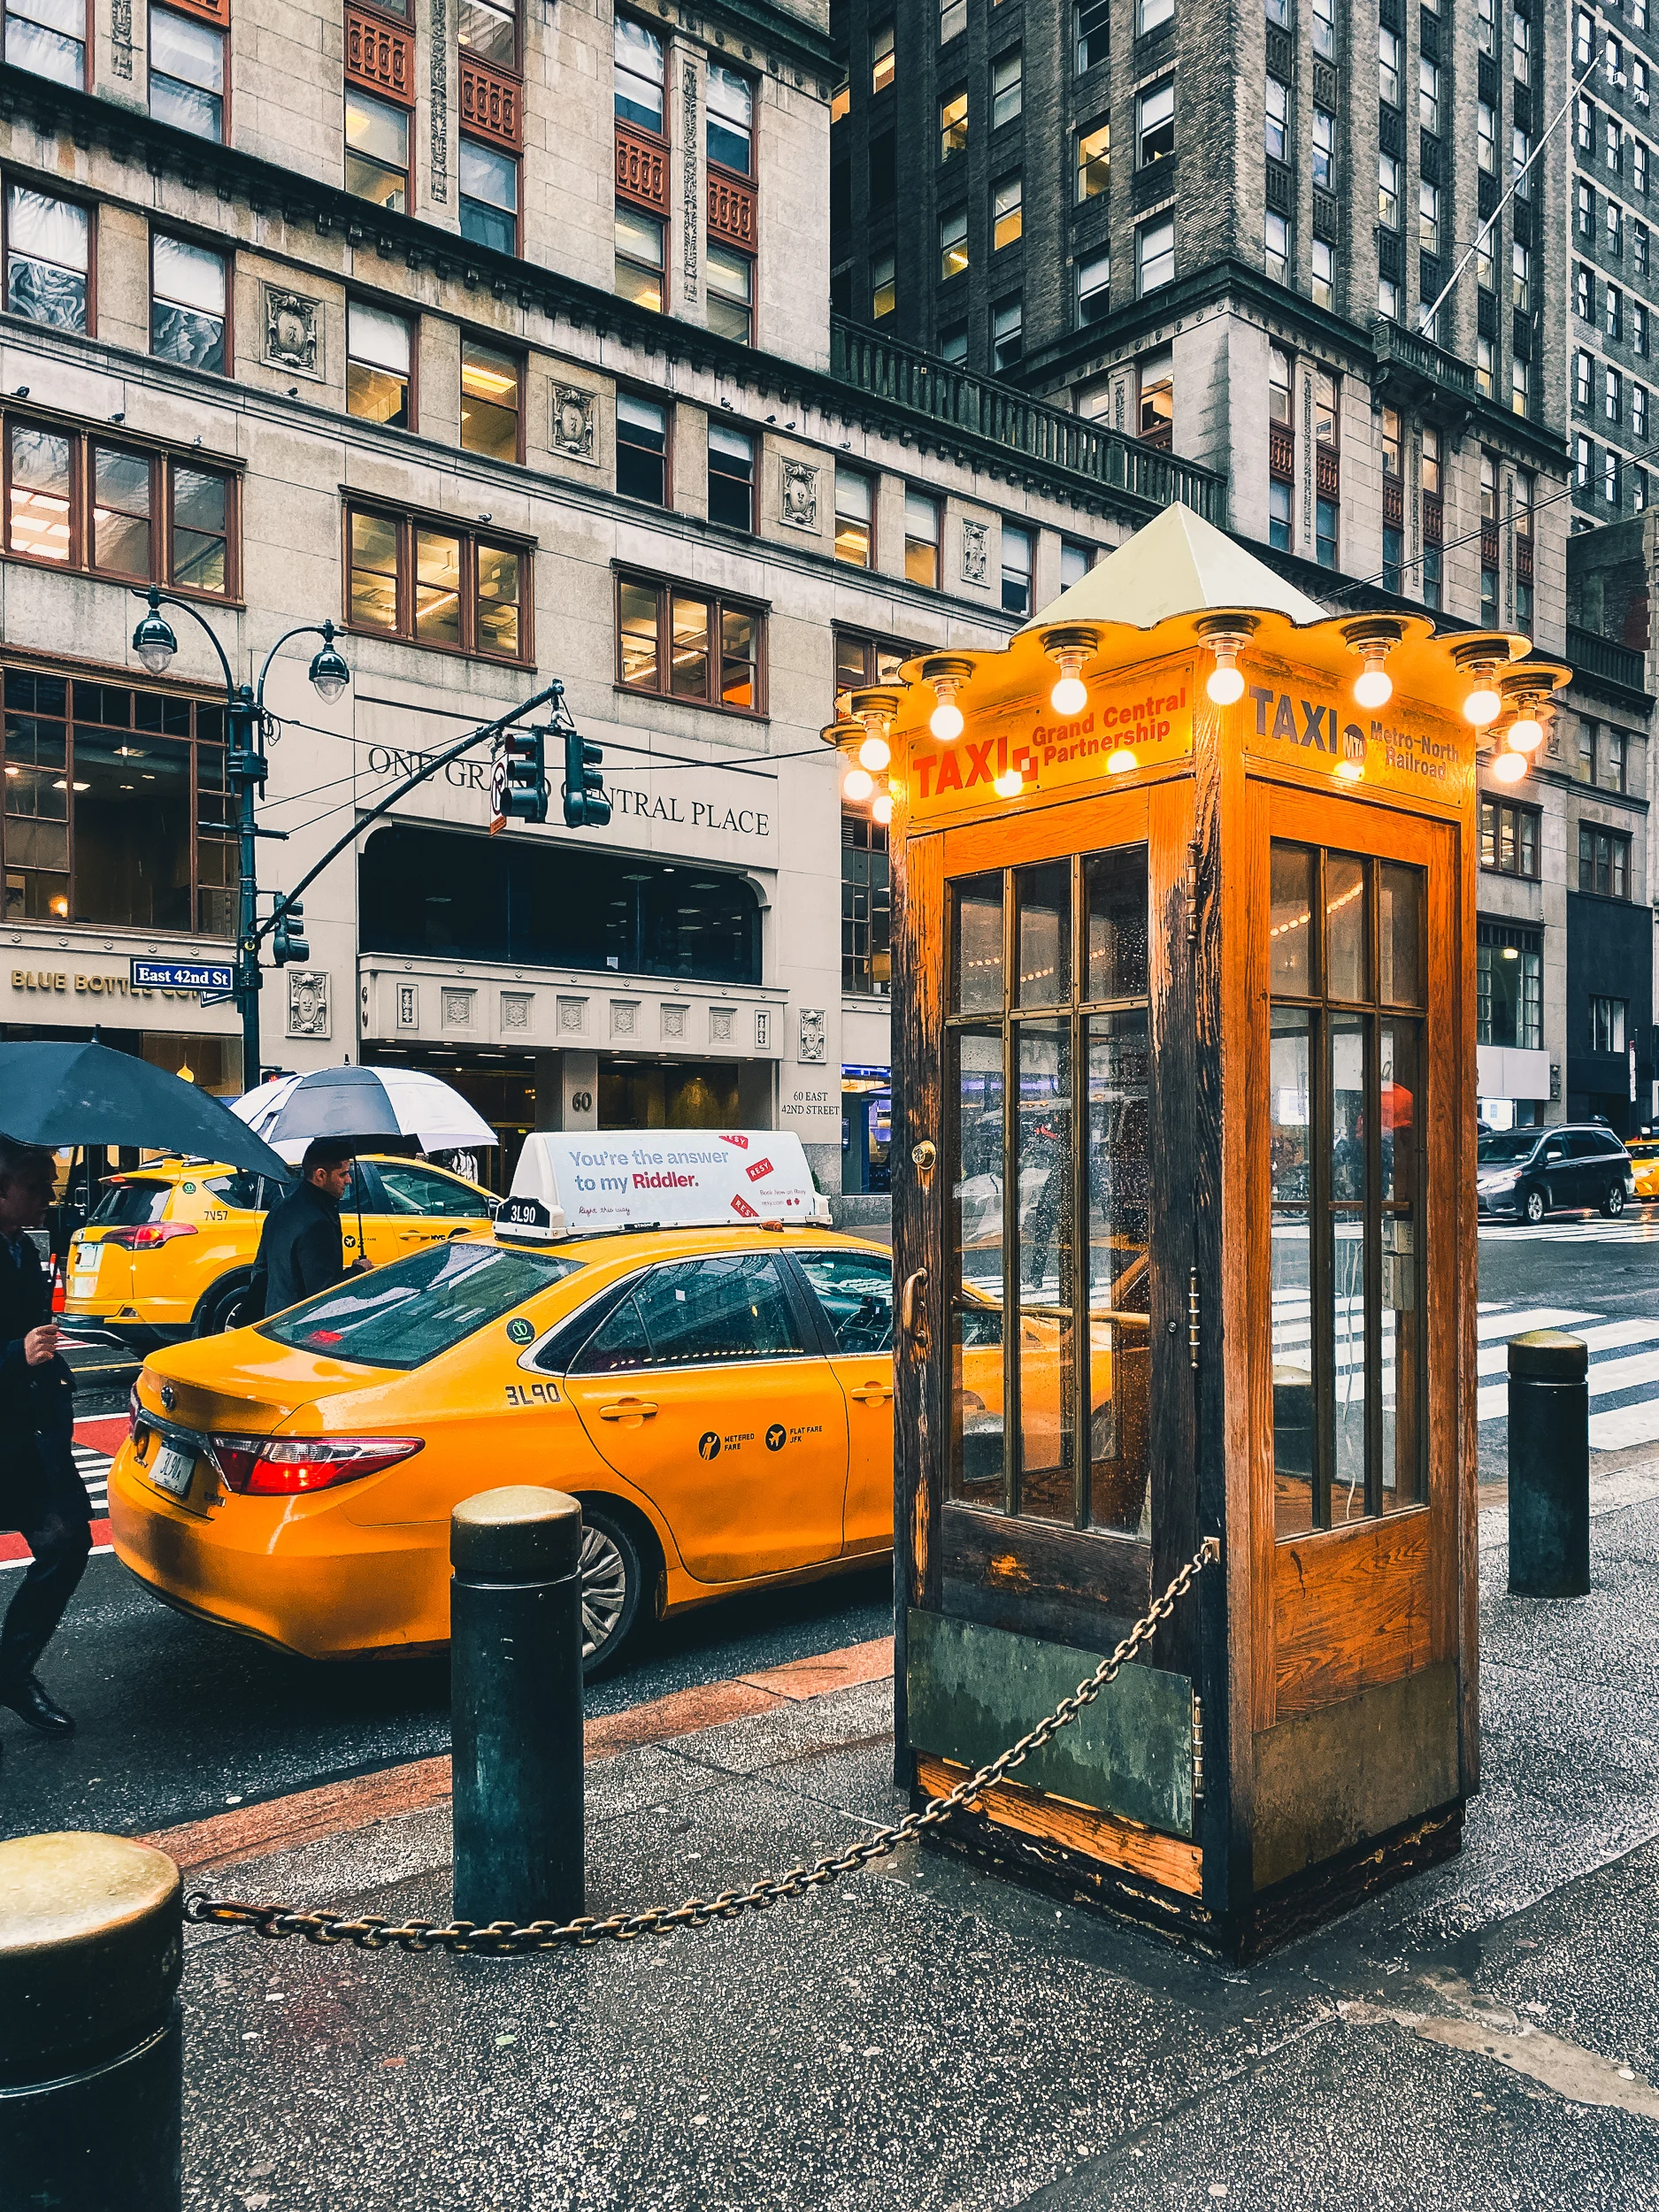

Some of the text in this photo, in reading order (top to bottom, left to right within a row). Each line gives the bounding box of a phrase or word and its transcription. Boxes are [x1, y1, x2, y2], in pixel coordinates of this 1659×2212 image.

[1033, 687, 1186, 747] Grand Central
[1249, 684, 1337, 755] TAXI
[1044, 718, 1171, 766] Partnership
[1343, 732, 1364, 758] MTA
[1371, 720, 1459, 764] Metro-North
[913, 735, 1008, 799] TAXI
[1386, 746, 1447, 780] Railroad
[368, 747, 435, 782] ONE
[561, 778, 685, 824] NTRAL
[691, 802, 770, 836] PLACE
[12, 970, 66, 989] BLUE
[139, 967, 228, 986] East 42nd St
[572, 1091, 593, 1112] 60
[794, 1091, 828, 1102] 60 EAST
[781, 1104, 840, 1116] 42ND STREET
[568, 1149, 729, 1167] You're the answer
[749, 1161, 770, 1178] RESY
[575, 1171, 700, 1194] to my Riddler.
[204, 1210, 228, 1221] 7V57
[511, 1204, 536, 1224] 3L90
[505, 1383, 561, 1406] 3L90
[724, 1432, 755, 1443] METERED
[789, 1426, 805, 1435] FLAT
[724, 1443, 741, 1452] FARE
